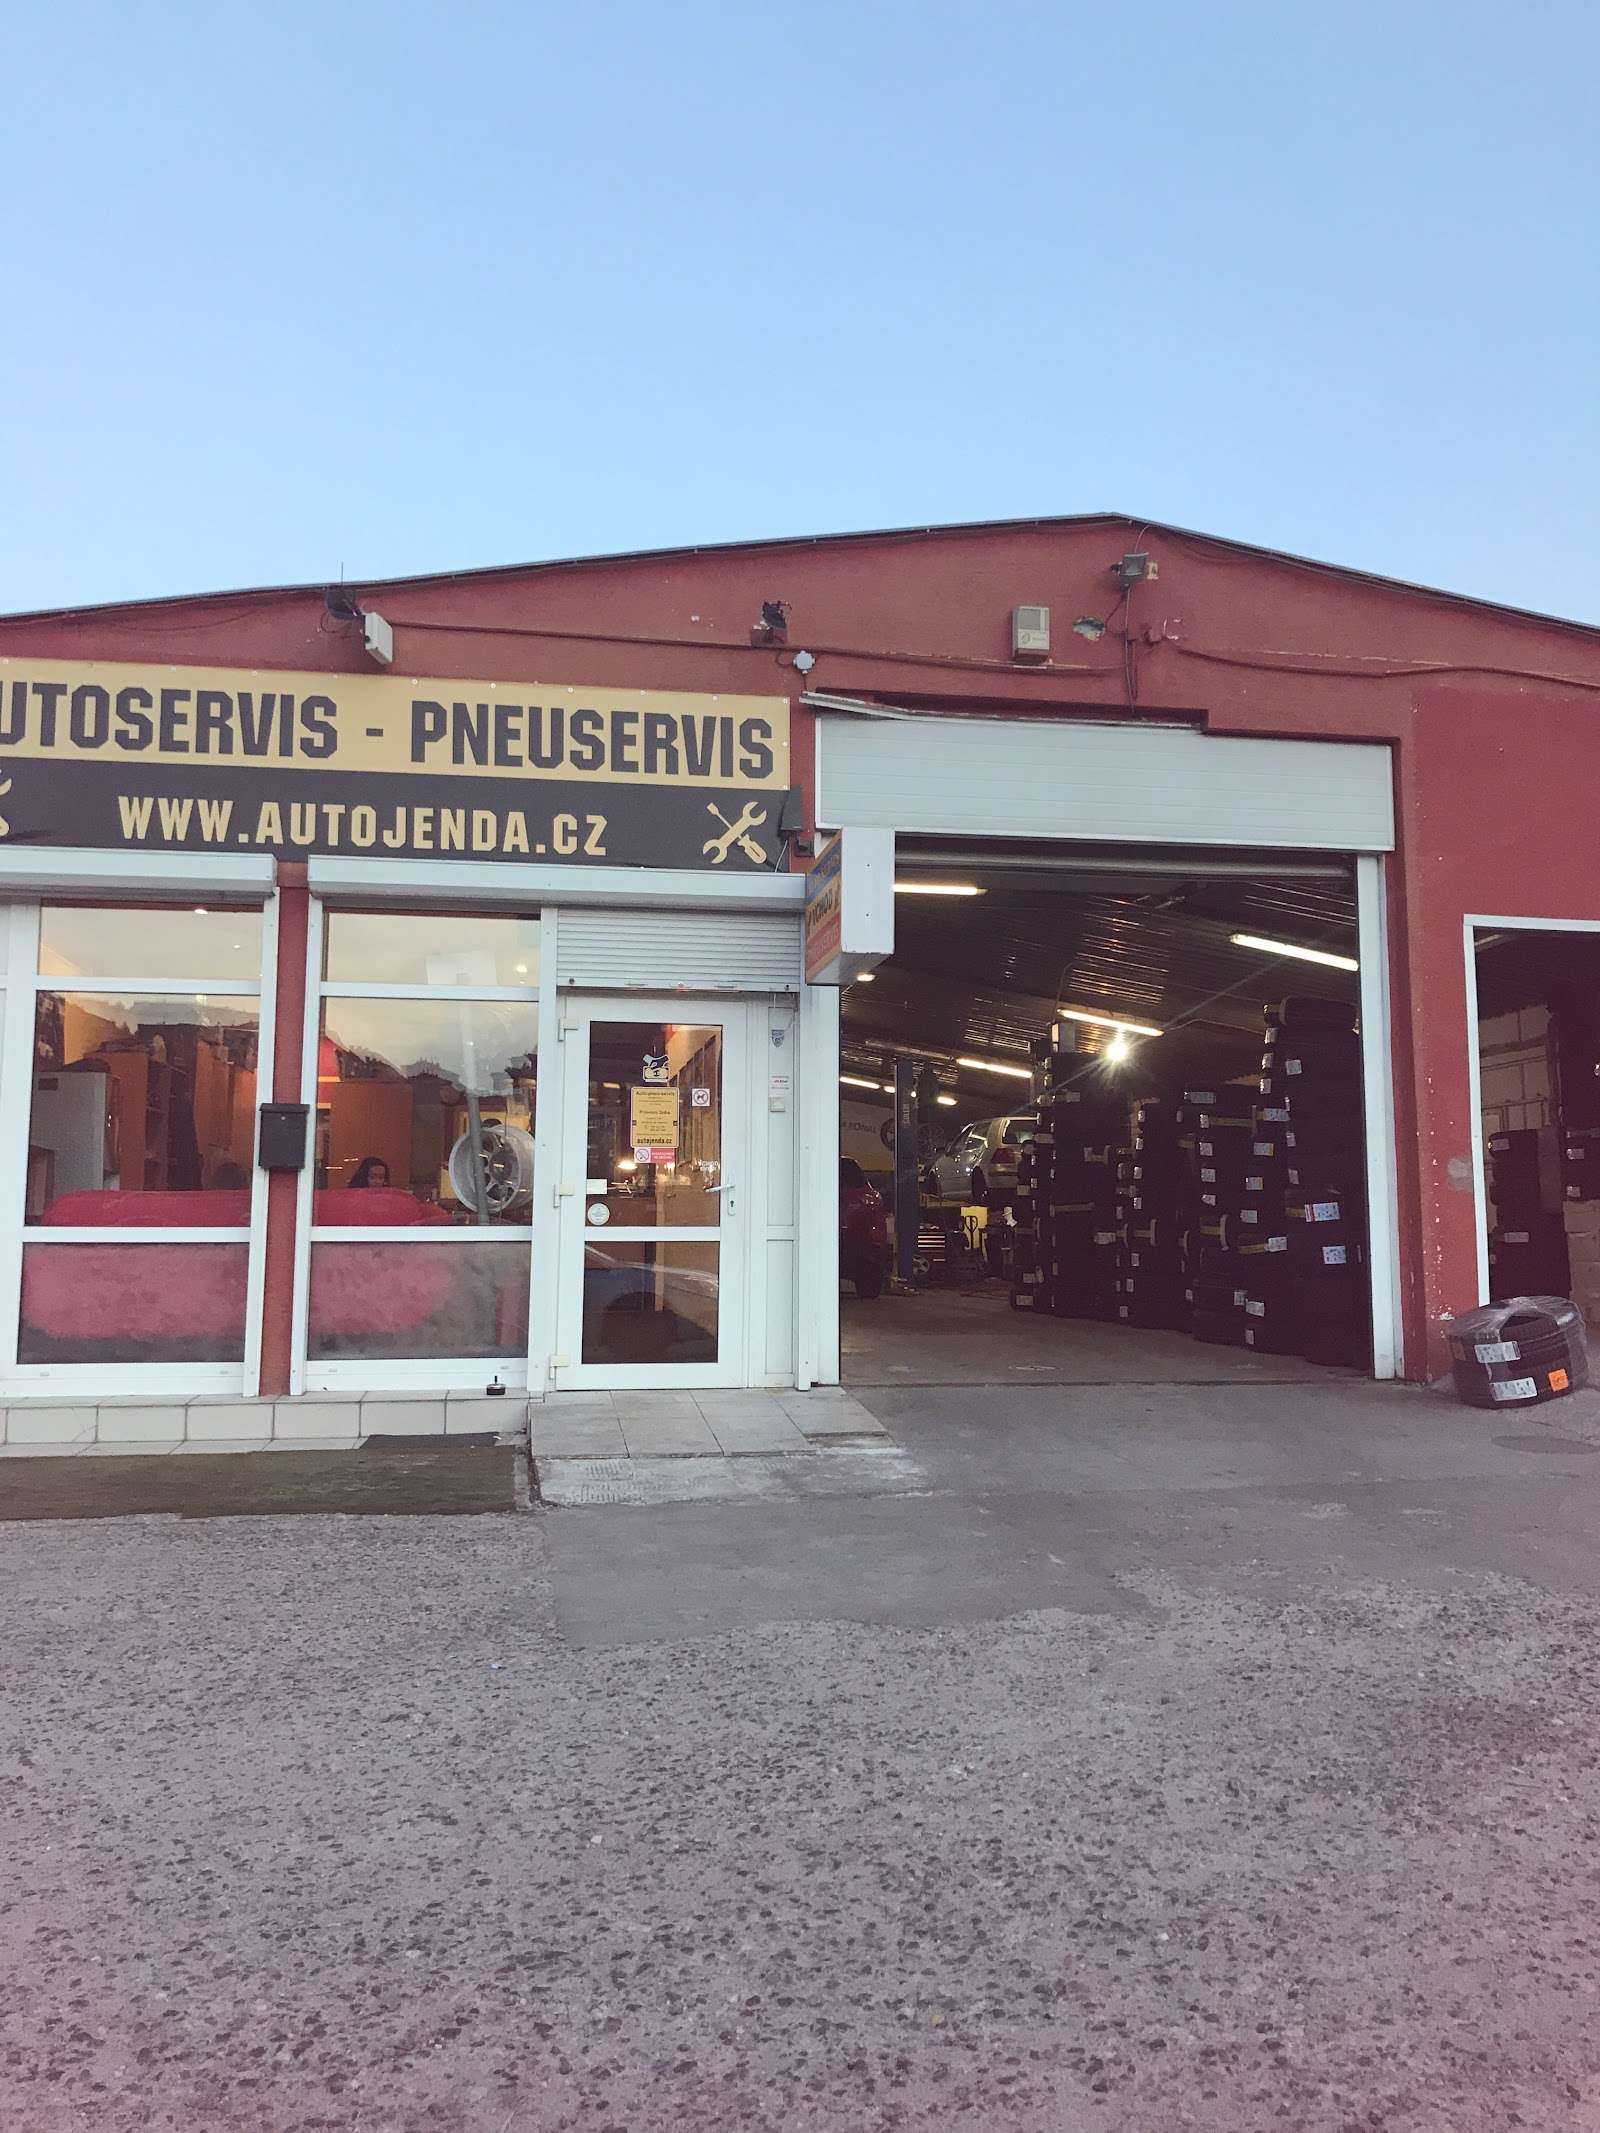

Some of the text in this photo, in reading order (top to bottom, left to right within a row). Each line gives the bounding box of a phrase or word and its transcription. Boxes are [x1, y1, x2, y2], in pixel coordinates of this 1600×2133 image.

[365, 728, 384, 737] -
[411, 700, 774, 779] PNEUSERVIS
[118, 796, 608, 856] WWW.AUTOJENDA.CZ
